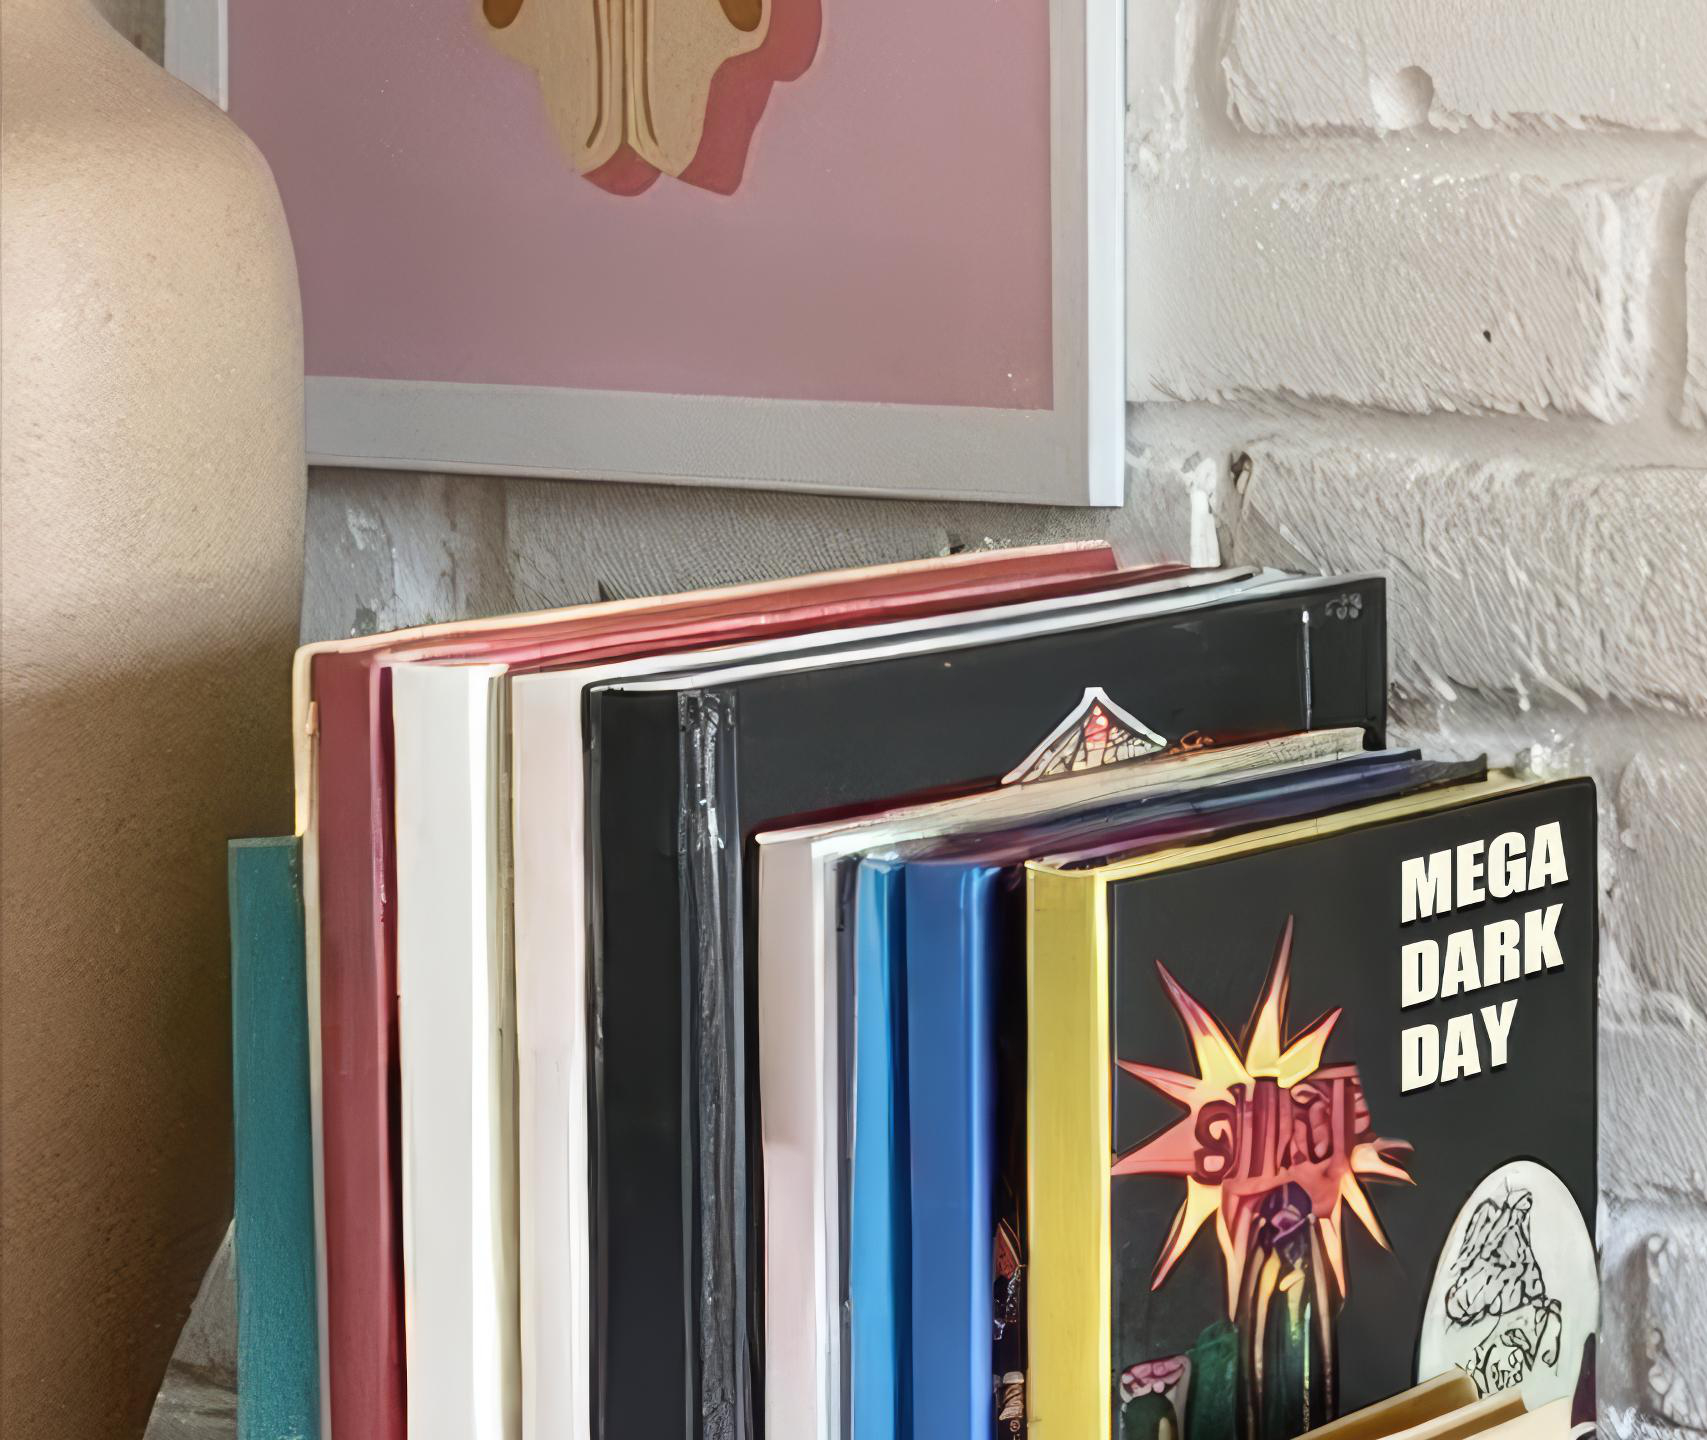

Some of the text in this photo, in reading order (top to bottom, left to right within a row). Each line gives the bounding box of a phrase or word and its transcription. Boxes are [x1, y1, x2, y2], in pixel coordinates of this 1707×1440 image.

[1401, 821, 1569, 924] MEGA
[1401, 903, 1564, 1009] DARK
[1401, 998, 1518, 1093] DAY
